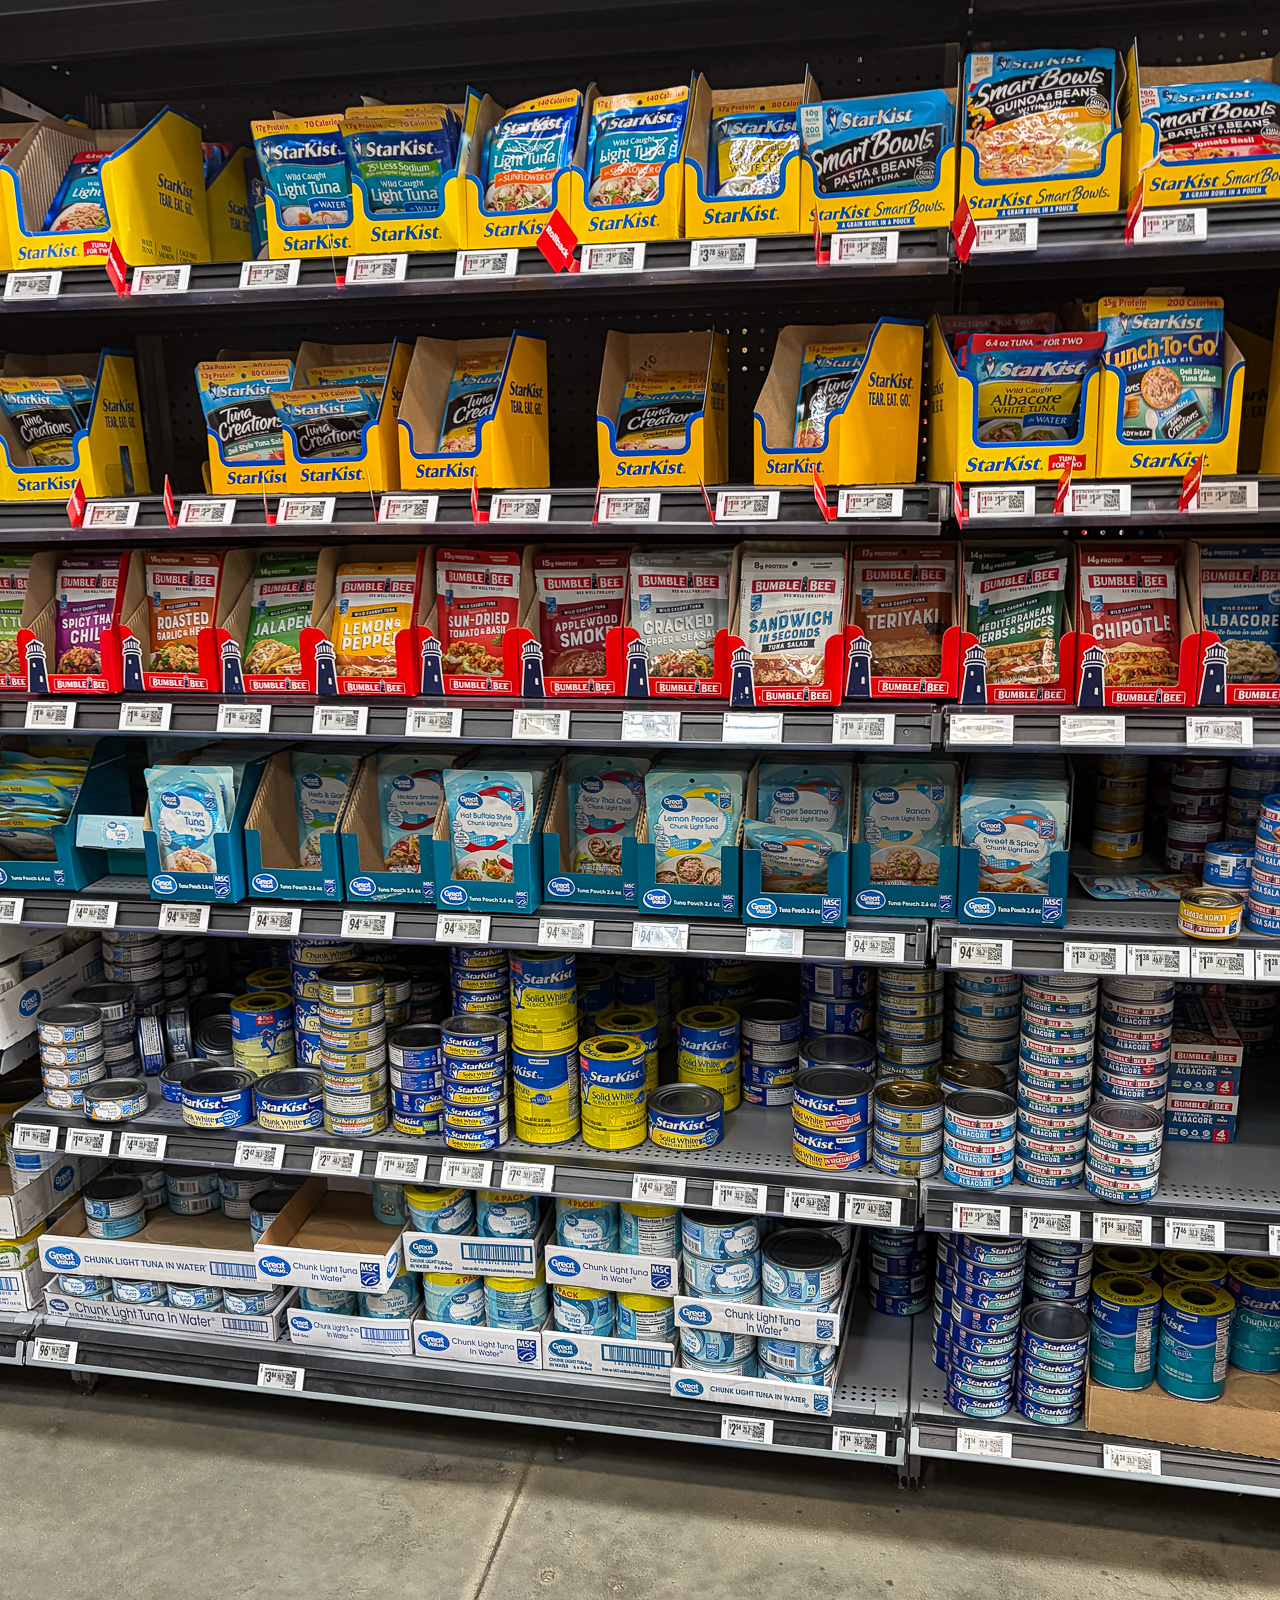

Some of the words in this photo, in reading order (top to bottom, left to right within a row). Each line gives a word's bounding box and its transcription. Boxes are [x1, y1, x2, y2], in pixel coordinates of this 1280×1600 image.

[976, 74, 1036, 108] Smart
[1039, 66, 1103, 92] Bowls
[538, 99, 549, 107] 140
[550, 96, 574, 105] Calories
[995, 95, 1045, 116] QUINOA
[1055, 87, 1097, 97] BEANS
[607, 112, 674, 129] StarKist
[840, 107, 912, 130] StarKist
[366, 140, 434, 157] StarKist
[1193, 139, 1227, 148] Tomato
[274, 142, 338, 160] StarKist
[812, 142, 869, 175] Smart
[873, 128, 932, 156] Bowls
[380, 163, 398, 171] Less
[399, 163, 429, 172] Sodium
[834, 169, 869, 187] PASTA
[881, 156, 923, 172] BEANS
[302, 172, 326, 181] Caught
[158, 174, 193, 199] StarKist
[277, 183, 306, 198] Light
[308, 182, 341, 194] Tuna
[319, 201, 347, 209] WATER
[703, 205, 777, 224] StarKist
[371, 224, 440, 242] StarKist
[284, 234, 348, 251] StarKist
[545, 224, 569, 258] Rollback
[18, 243, 77, 260] StarKist
[1167, 299, 1184, 307] 200
[1186, 298, 1218, 307] Calories
[1131, 314, 1203, 330] StarKist
[985, 338, 998, 347] 6.4
[1010, 339, 1034, 347] TUNA
[1043, 337, 1060, 346] FOR
[1061, 337, 1083, 346] TWO
[997, 359, 1086, 378] StarKist
[1127, 362, 1147, 371] TUNA
[1151, 358, 1178, 366] SALAD
[214, 371, 235, 379] Protein
[868, 372, 913, 390] StarKist
[868, 393, 884, 406] TEAR.
[886, 393, 899, 406] EAT.
[990, 393, 1061, 407] Albacore
[993, 405, 1025, 414] WHITE
[1028, 404, 1056, 413] TUNA
[18, 413, 43, 428] Tuna
[1036, 415, 1066, 425] WATER
[20, 423, 72, 443] Creations
[301, 466, 362, 482] StarKist
[616, 459, 683, 476] StarKist
[754, 562, 763, 570] 8g
[866, 570, 910, 581] BUMBLE
[921, 570, 943, 580] BEE
[343, 582, 382, 592] BUMBLE
[392, 581, 411, 591] BEE
[755, 581, 799, 591] BUMBLE
[810, 581, 832, 591] BEE
[158, 612, 208, 629] ROASTED
[449, 612, 509, 627] SUN-DRIED
[555, 615, 618, 632] APPLEWOOD
[643, 615, 714, 635] CRACKED
[750, 612, 833, 633] SANDWICH
[867, 609, 938, 630] TERIYAKI
[1017, 616, 1055, 633] SPICES
[1204, 614, 1278, 626] ALBACORE
[344, 619, 391, 635] LEMON
[394, 619, 401, 628] &
[450, 628, 479, 638] TOMATO
[1093, 615, 1170, 640] CHIPOTLE
[157, 629, 182, 641] GARLIC
[759, 634, 769, 643] IN
[772, 628, 820, 641] SECONDS
[152, 678, 183, 687] BUMBLE
[1116, 693, 1154, 701] BUMBLE
[1163, 693, 1182, 702] BEE
[692, 816, 718, 824] Pepper
[1017, 840, 1039, 849] Spicy
[523, 970, 571, 985] StarKist
[525, 993, 545, 1003] Solid
[547, 992, 568, 1003] White
[680, 1038, 727, 1050] StarKist
[1177, 1053, 1211, 1061] BUMBLE
[1176, 1067, 1217, 1076] ALBACORE
[1221, 1081, 1230, 1089] 4
[262, 1101, 307, 1112] StarKist
[262, 1116, 281, 1126] Chunk
[657, 1117, 705, 1131] StarKist
[959, 1178, 992, 1187] ALBACORE
[49, 1251, 74, 1261] Great
[84, 1256, 112, 1264] CHUNK
[114, 1257, 134, 1266] LIGHT
[136, 1259, 163, 1268] TUNA
[165, 1261, 173, 1269] IN
[176, 1263, 205, 1271] WATER
[651, 1266, 669, 1274] MSC
[75, 1302, 109, 1316] Chunk
[112, 1306, 134, 1324] Light
[136, 1309, 165, 1322] Tuna
[168, 1312, 177, 1324] In
[725, 1308, 754, 1321] Chunk
[756, 1311, 778, 1325] Light
[779, 1314, 801, 1326] Tuna
[746, 1324, 755, 1333] In
[757, 1324, 782, 1335] Water
[1041, 1343, 1077, 1351] StarKist
